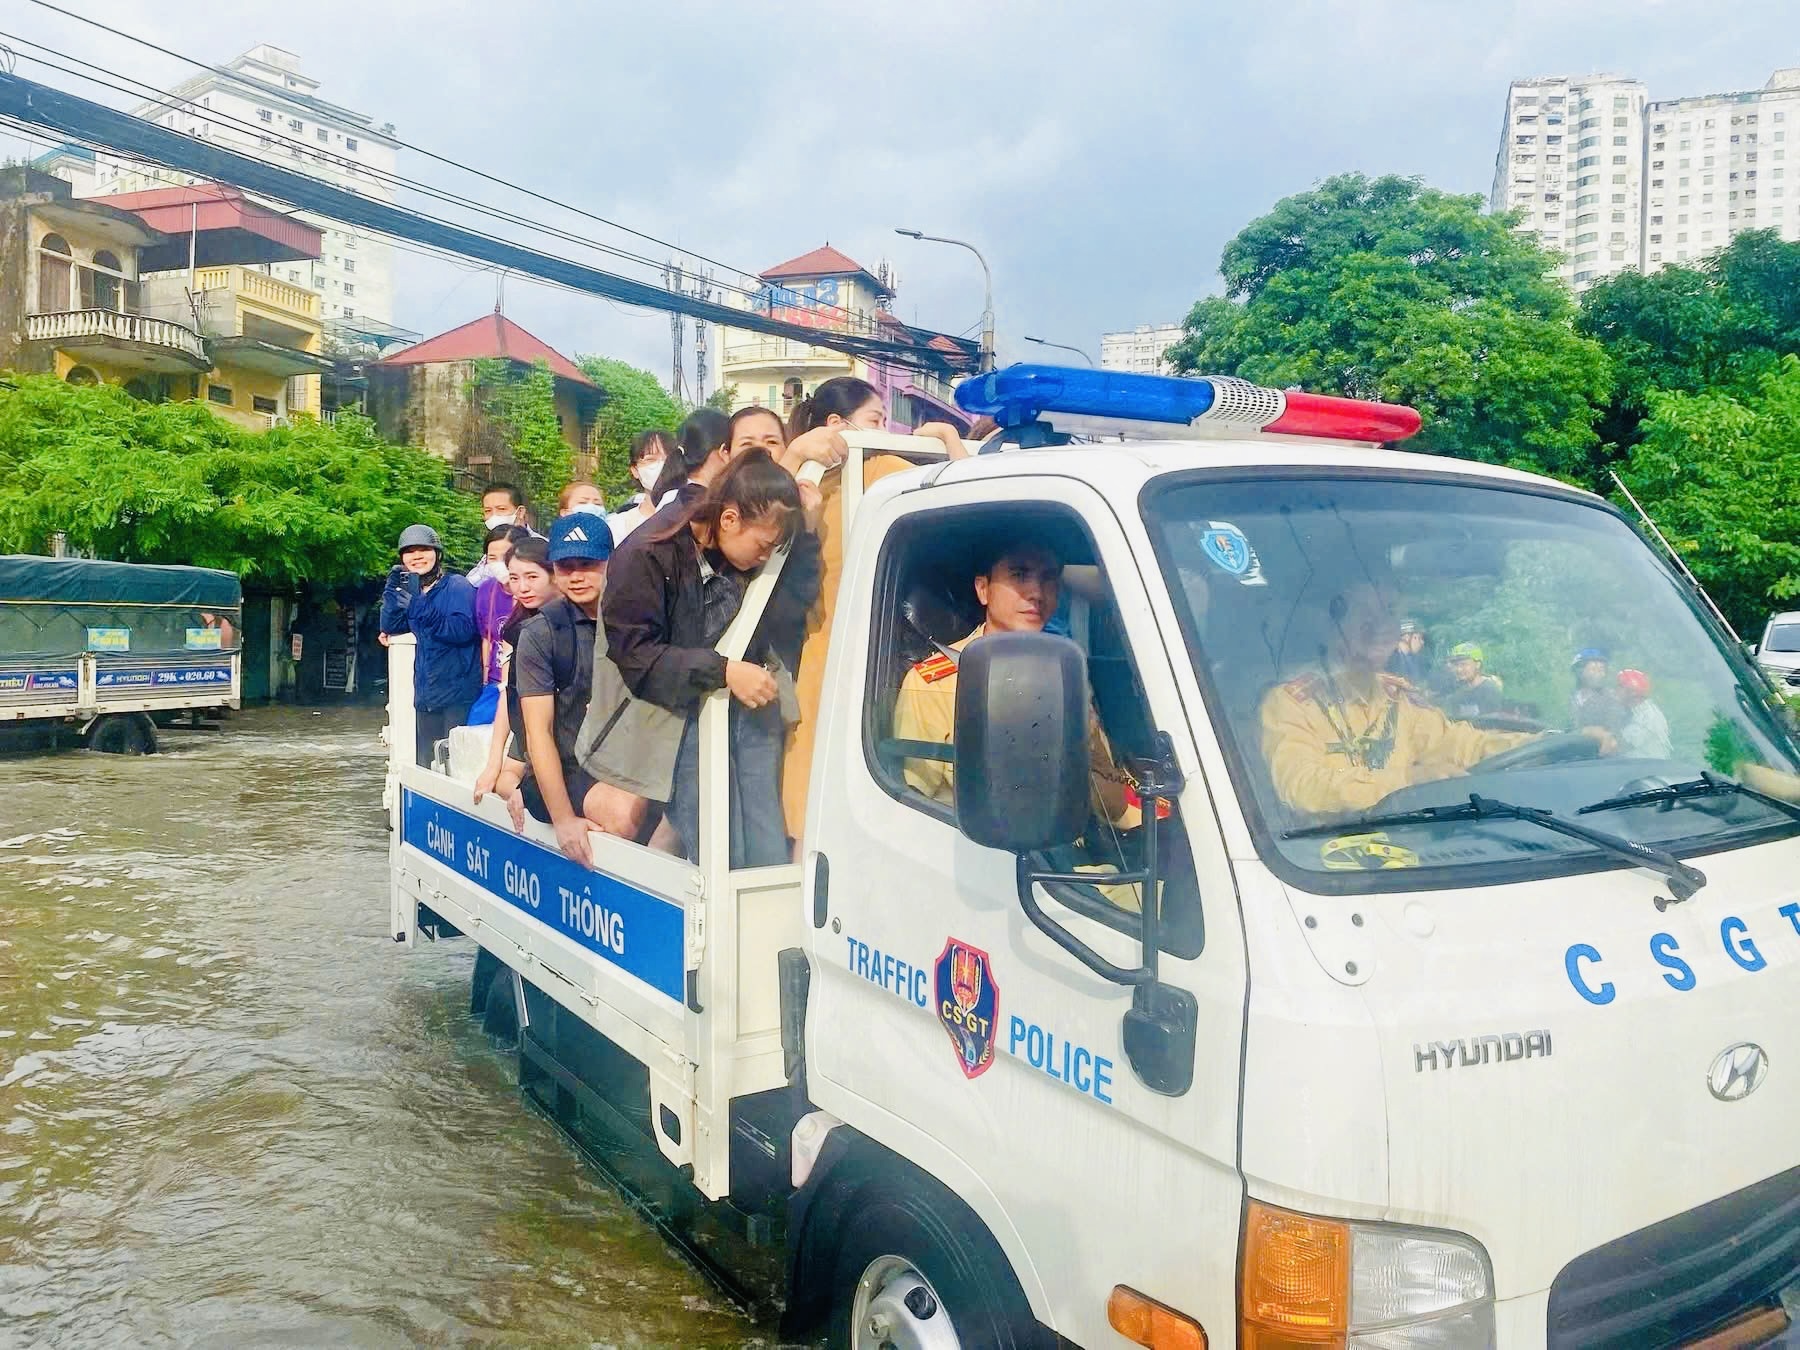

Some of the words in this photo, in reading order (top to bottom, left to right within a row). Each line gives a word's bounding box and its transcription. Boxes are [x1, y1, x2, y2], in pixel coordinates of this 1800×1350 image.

[427, 812, 455, 861] CẢNH
[466, 836, 489, 879] SÁT
[504, 860, 540, 909] GIAO
[558, 886, 625, 955] THÔNG
[847, 936, 927, 1008] TRAFFIC
[1009, 1015, 1113, 1105] POLICE
[1413, 1029, 1553, 1073] HYUNDAI
